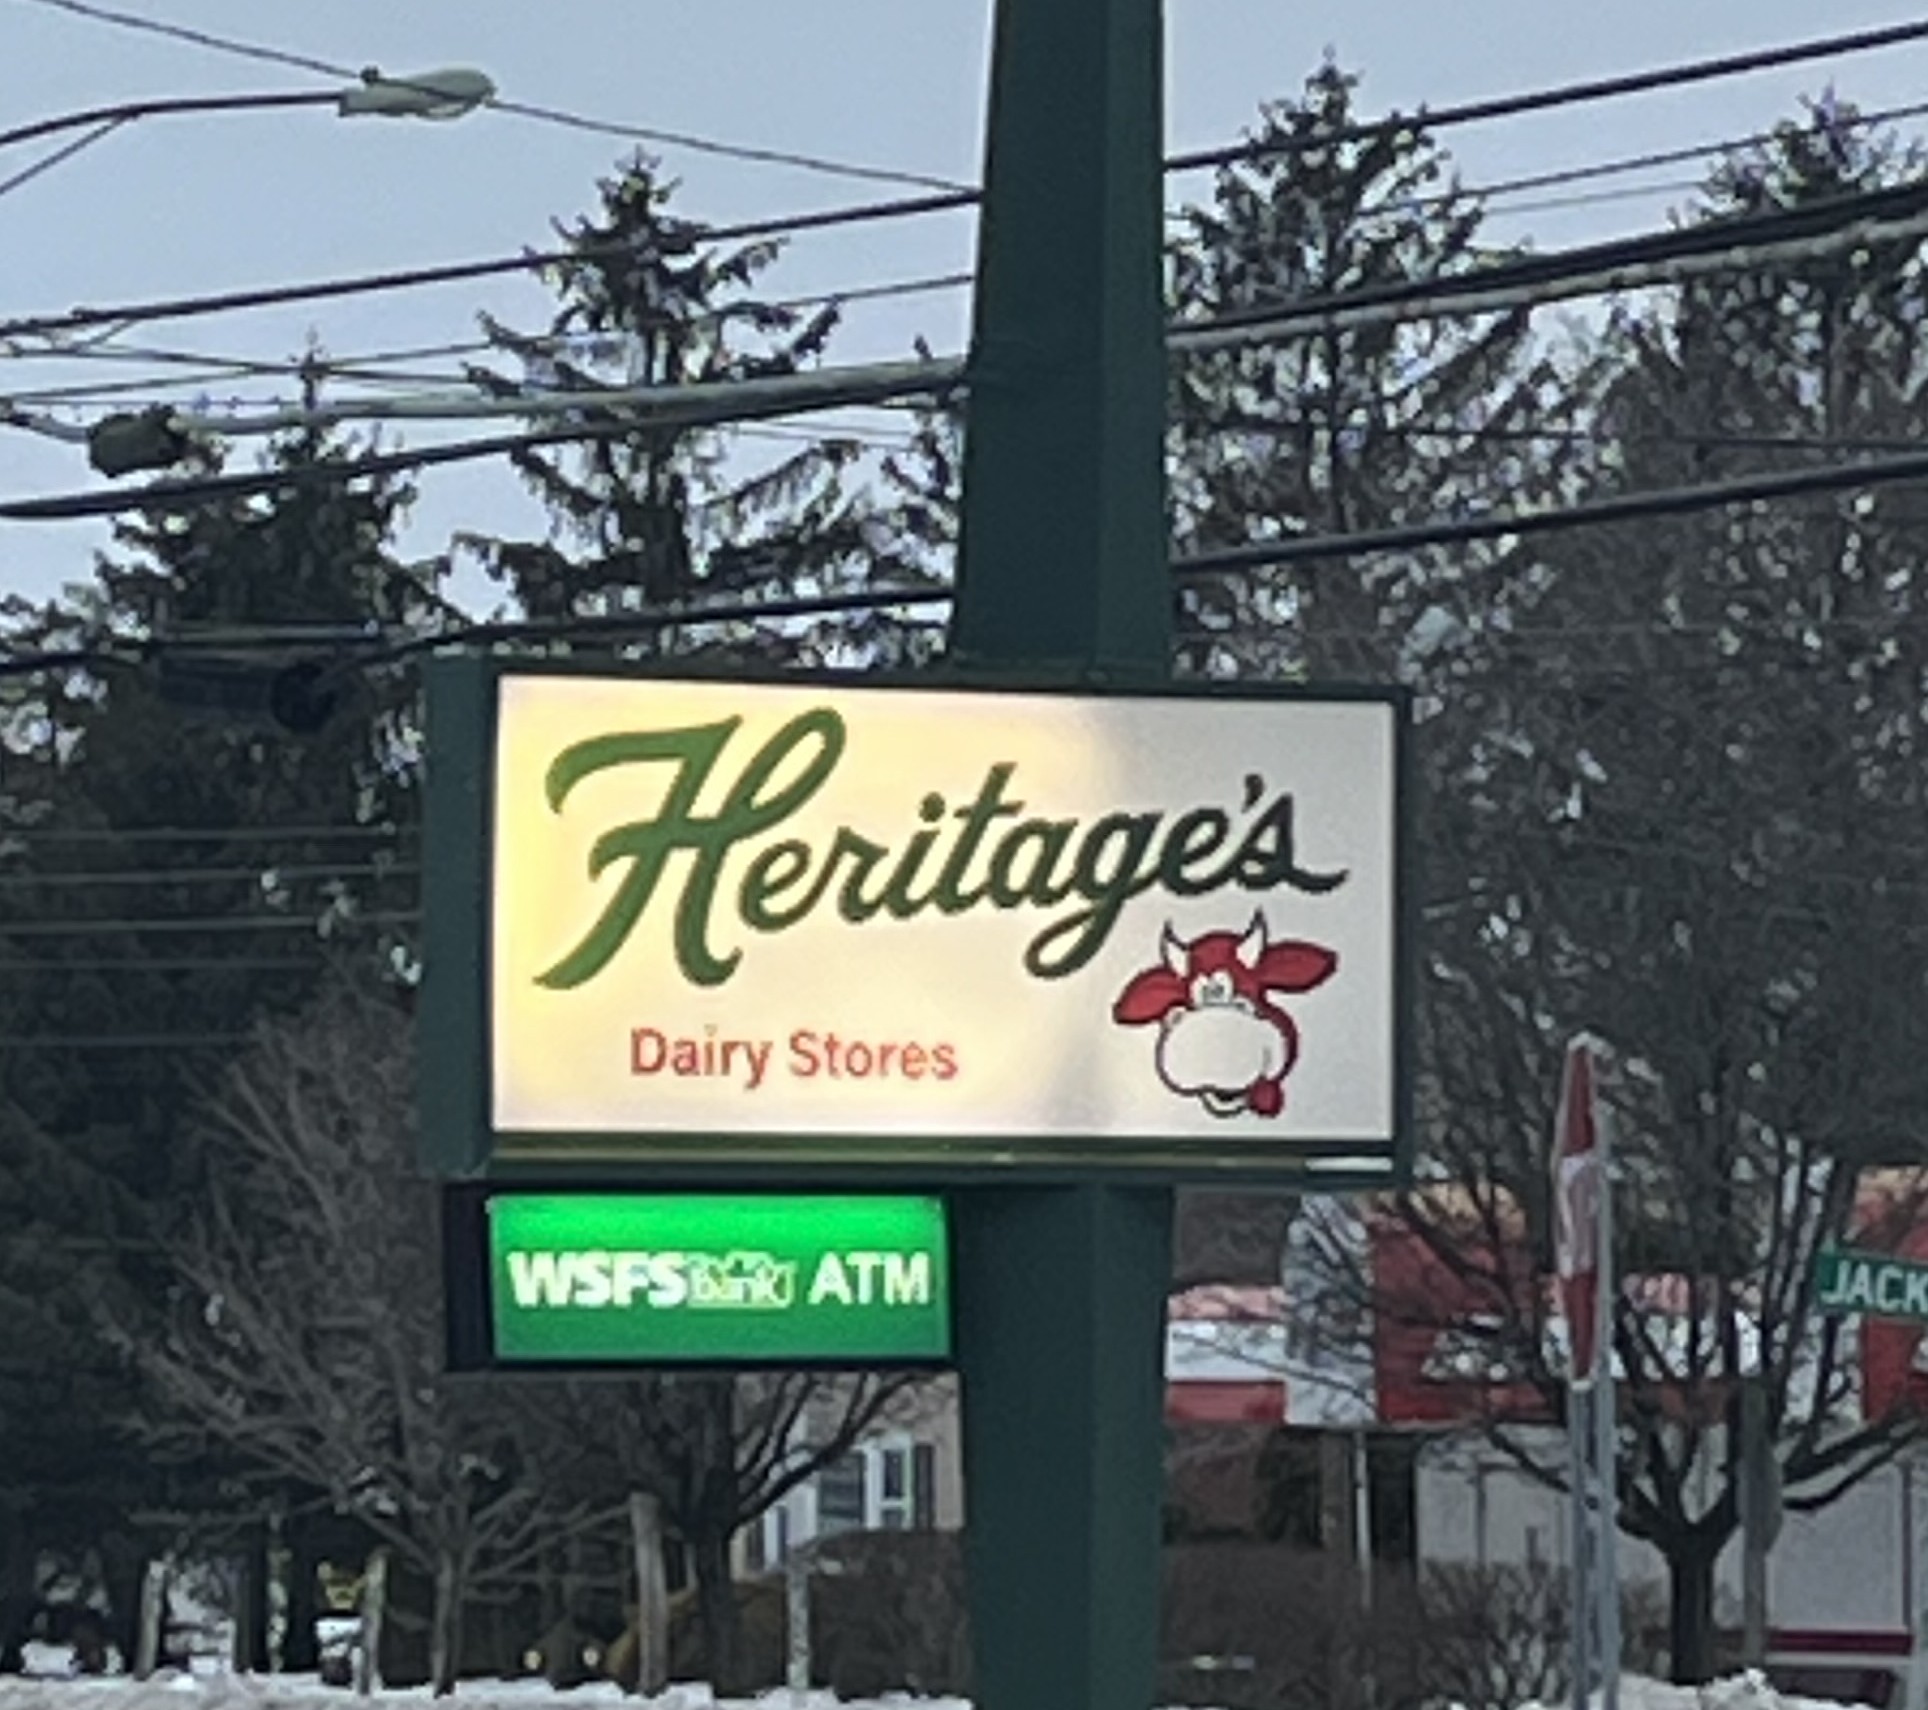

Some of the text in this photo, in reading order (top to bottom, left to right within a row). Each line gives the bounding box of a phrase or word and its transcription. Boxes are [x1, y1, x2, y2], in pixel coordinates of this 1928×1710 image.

[533, 707, 1349, 988] Heritage's
[630, 1024, 958, 1091] Dairy Stores
[507, 1250, 688, 1308] WSFS
[807, 1251, 931, 1306] ATM
